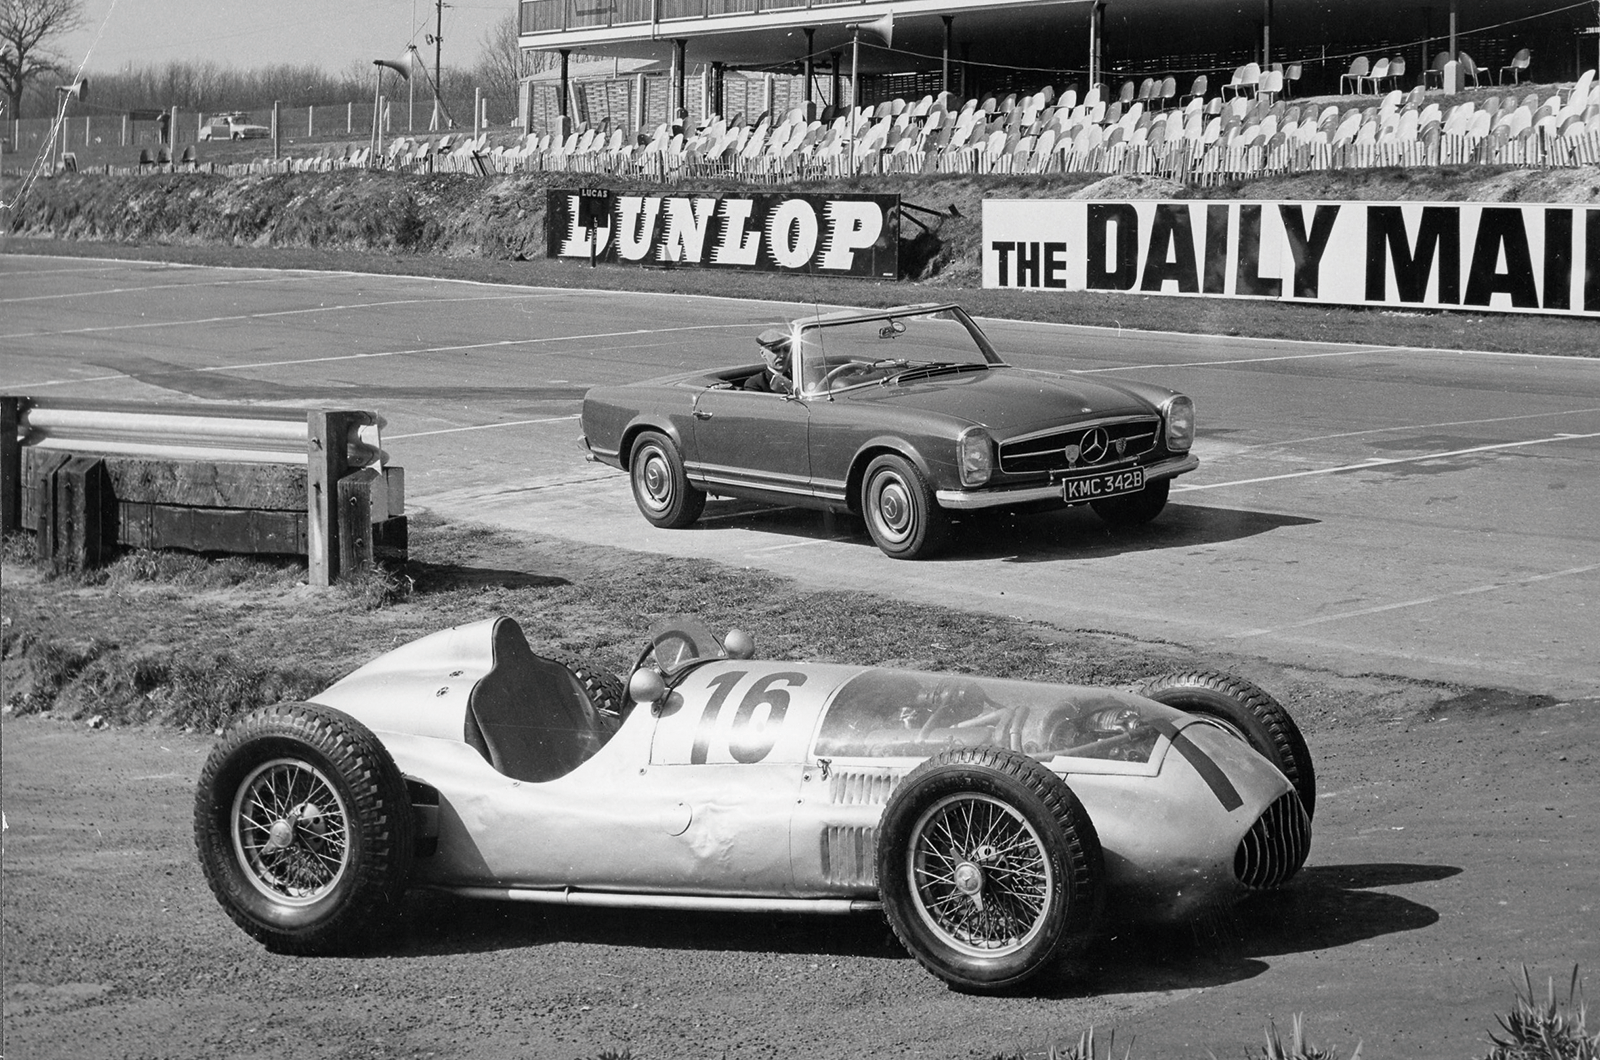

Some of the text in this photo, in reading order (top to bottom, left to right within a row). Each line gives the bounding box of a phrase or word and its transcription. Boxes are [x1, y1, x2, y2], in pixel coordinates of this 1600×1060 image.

[581, 188, 608, 198] LUCAS
[992, 241, 1067, 288] THE
[1086, 203, 1341, 299] DAILY
[1068, 471, 1142, 498] KMC 342B
[690, 670, 808, 764] 16
